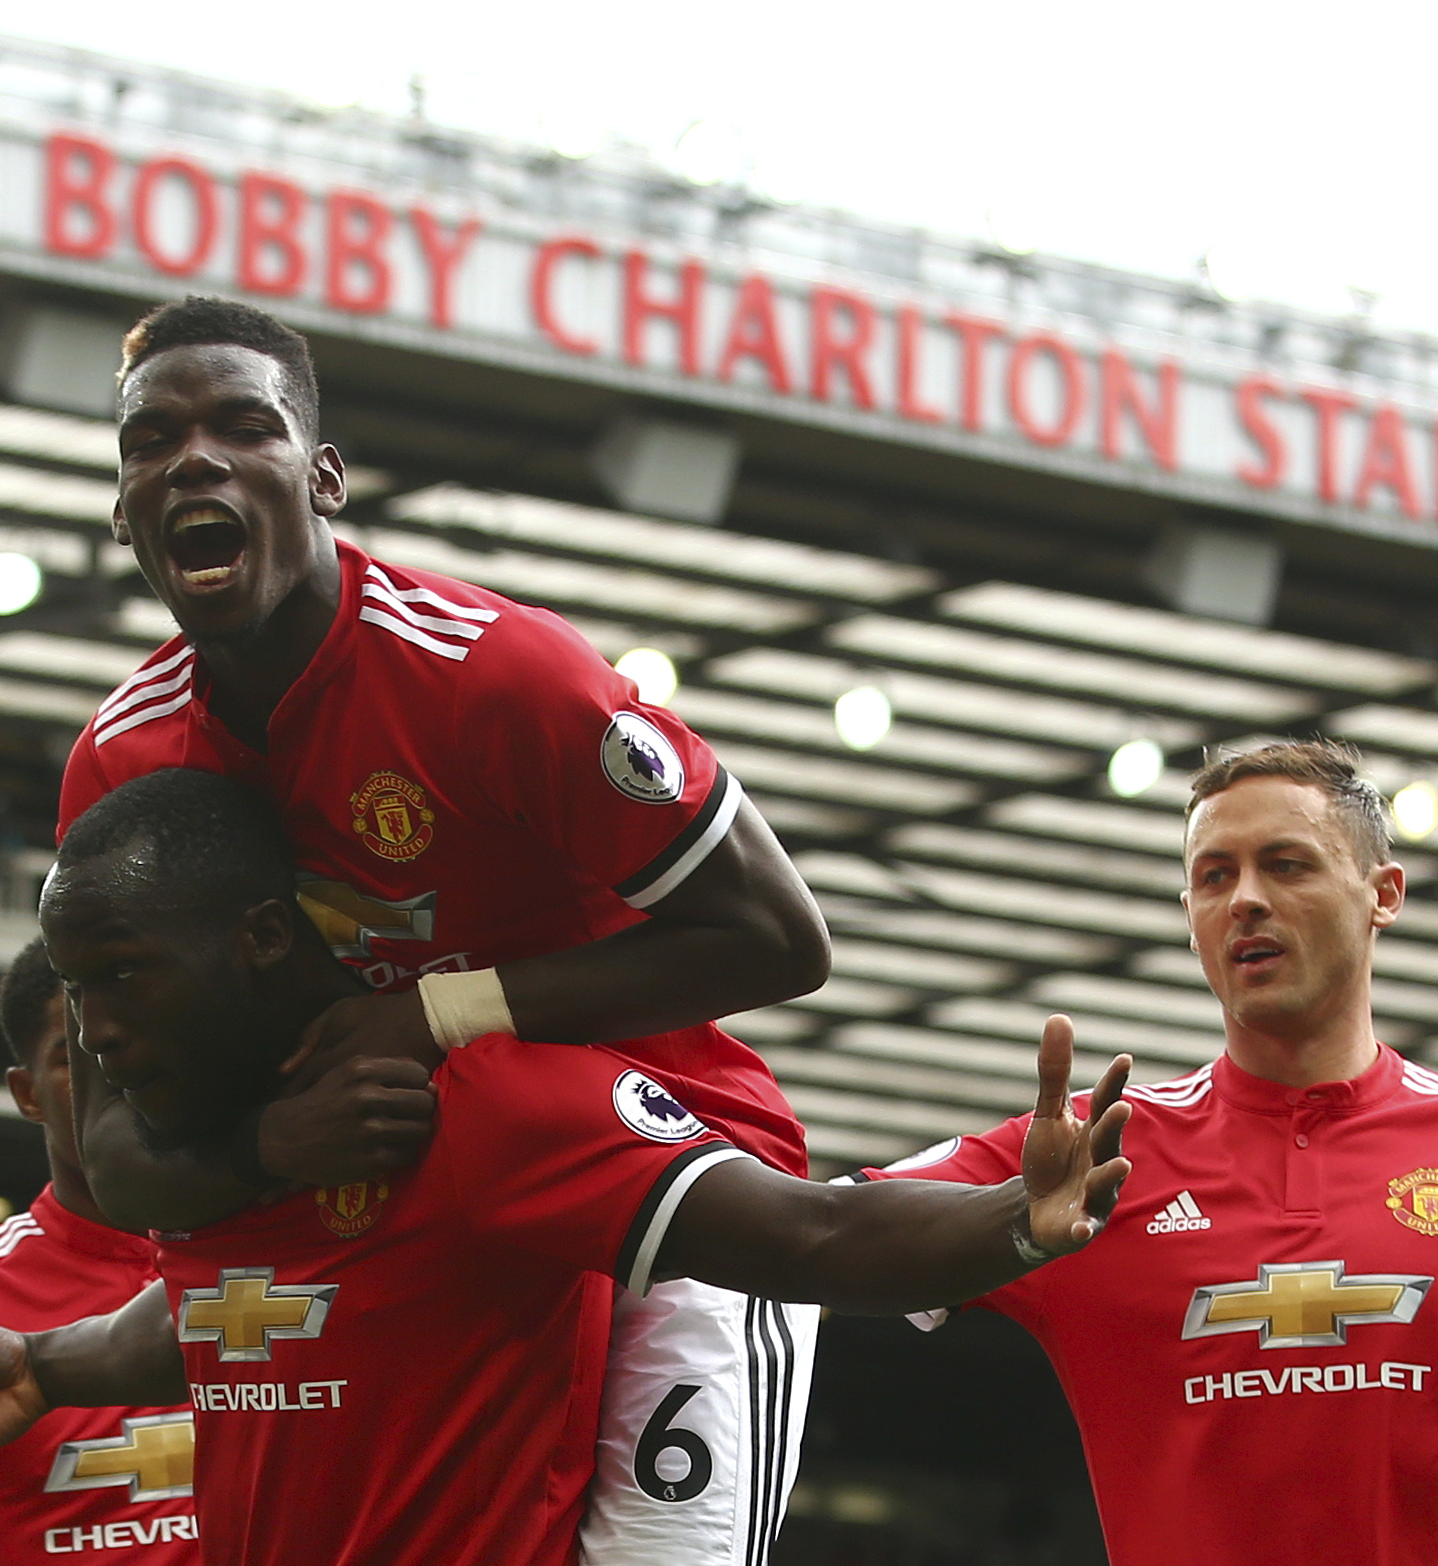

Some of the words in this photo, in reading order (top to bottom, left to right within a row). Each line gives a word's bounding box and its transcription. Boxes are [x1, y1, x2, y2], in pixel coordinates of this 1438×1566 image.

[43, 131, 484, 330] BOBBY
[528, 237, 1182, 472] CHARLTON
[356, 776, 422, 811] MANCHESTER
[378, 837, 425, 857] UNITED
[1146, 1217, 1212, 1235] adidas
[1184, 1361, 1431, 1404] CHEVROLET
[633, 1384, 713, 1503] 6
[44, 1515, 198, 1553] CHEVR
